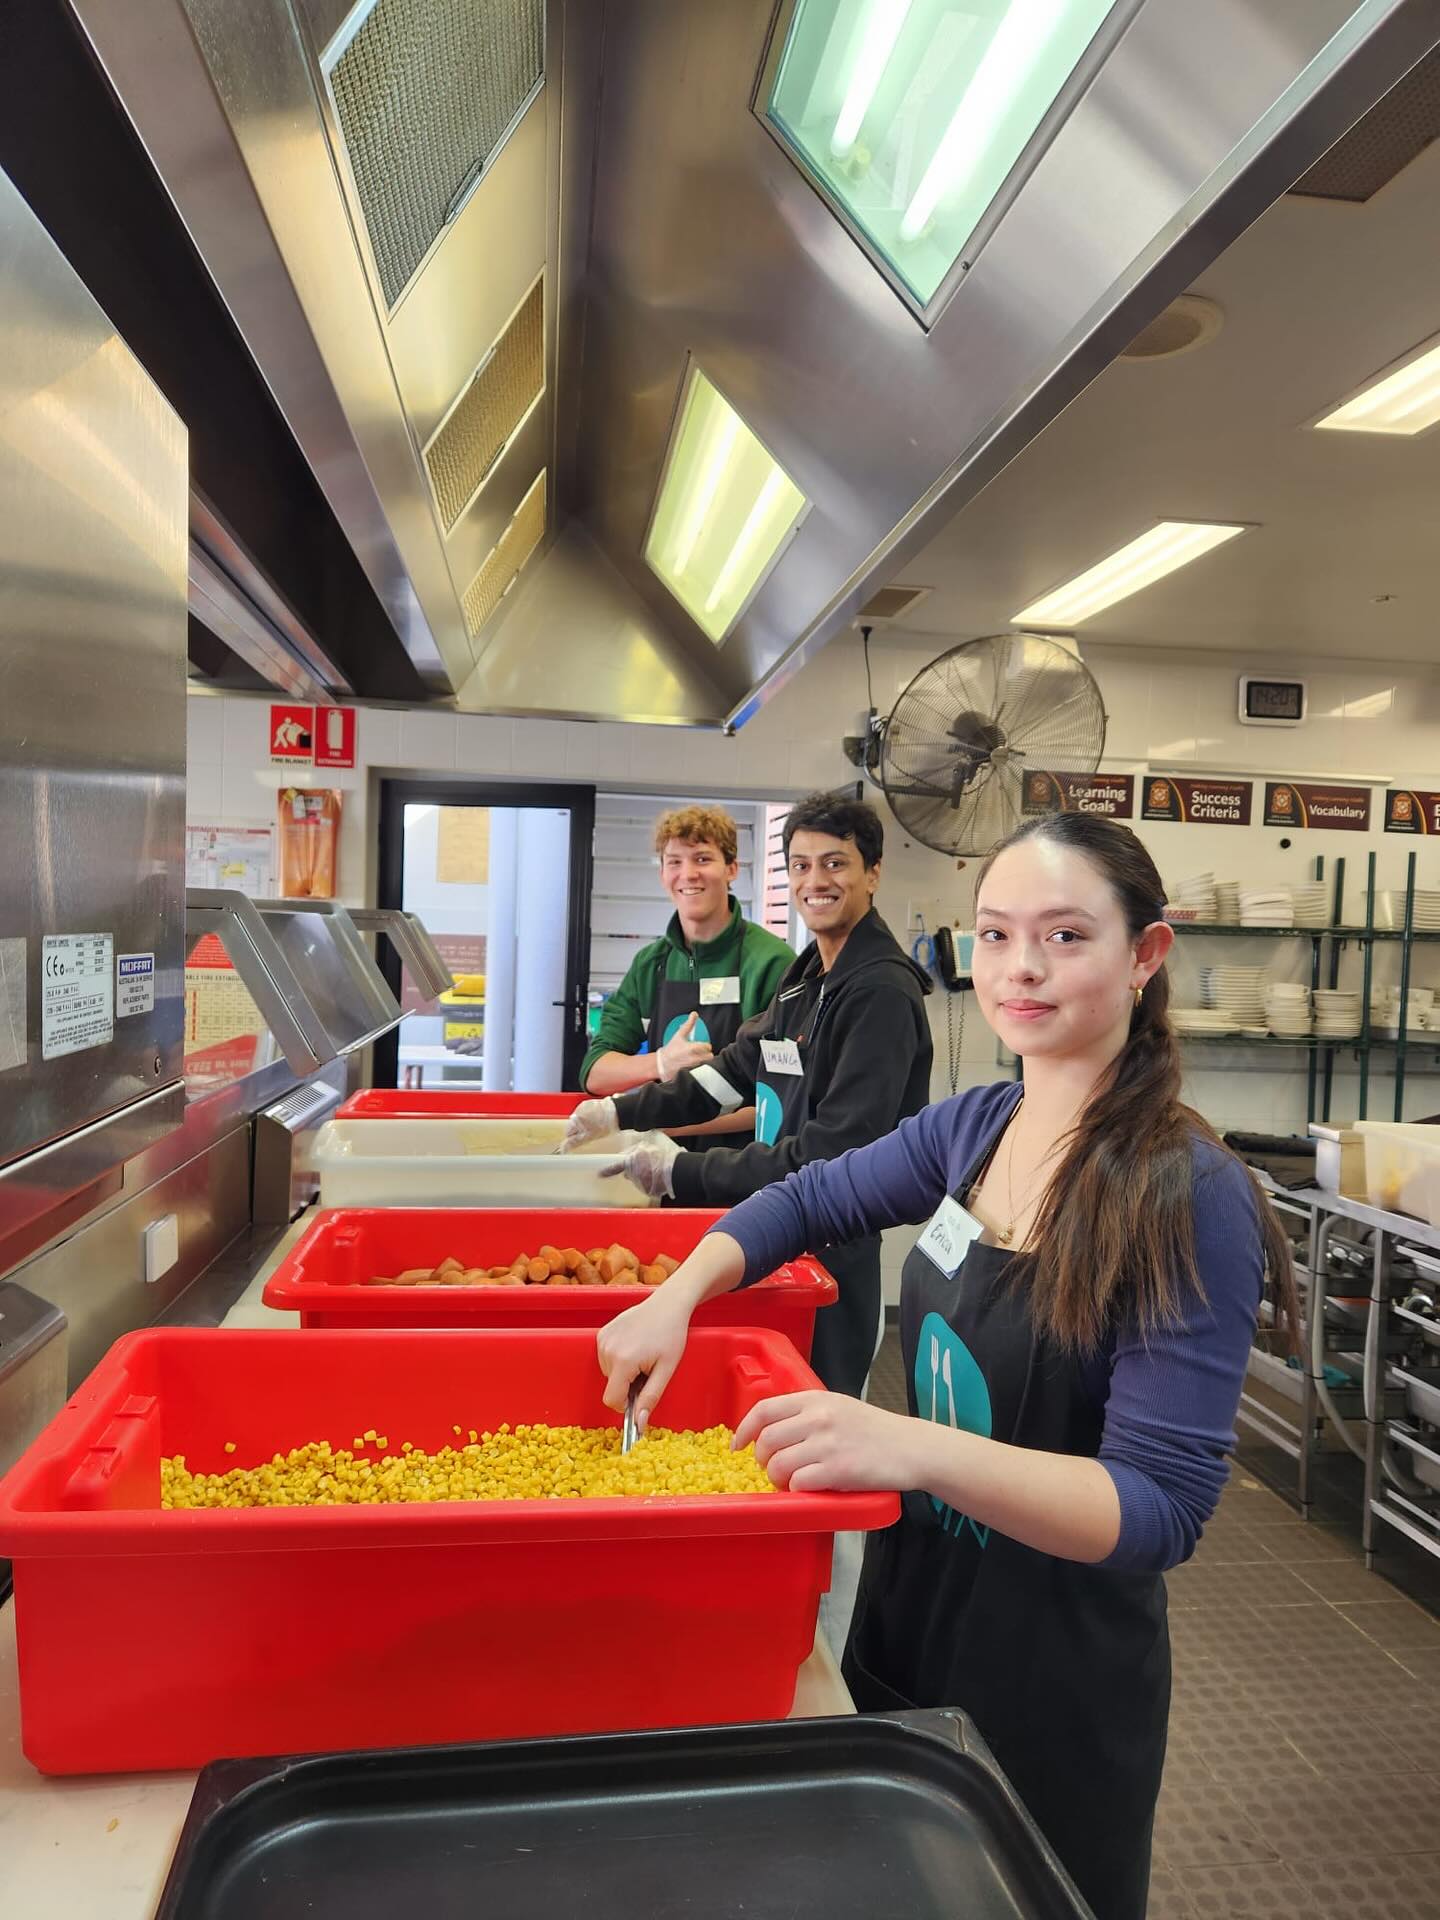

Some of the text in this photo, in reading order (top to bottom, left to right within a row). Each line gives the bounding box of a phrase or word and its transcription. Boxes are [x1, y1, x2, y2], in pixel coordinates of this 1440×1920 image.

[1069, 784, 1127, 802] Learning
[1191, 790, 1241, 806] Success
[1079, 798, 1116, 813] Goals
[1190, 804, 1240, 819] Criteria
[1309, 804, 1366, 819] Vocabulary
[121, 960, 152, 972] MOFFAT
